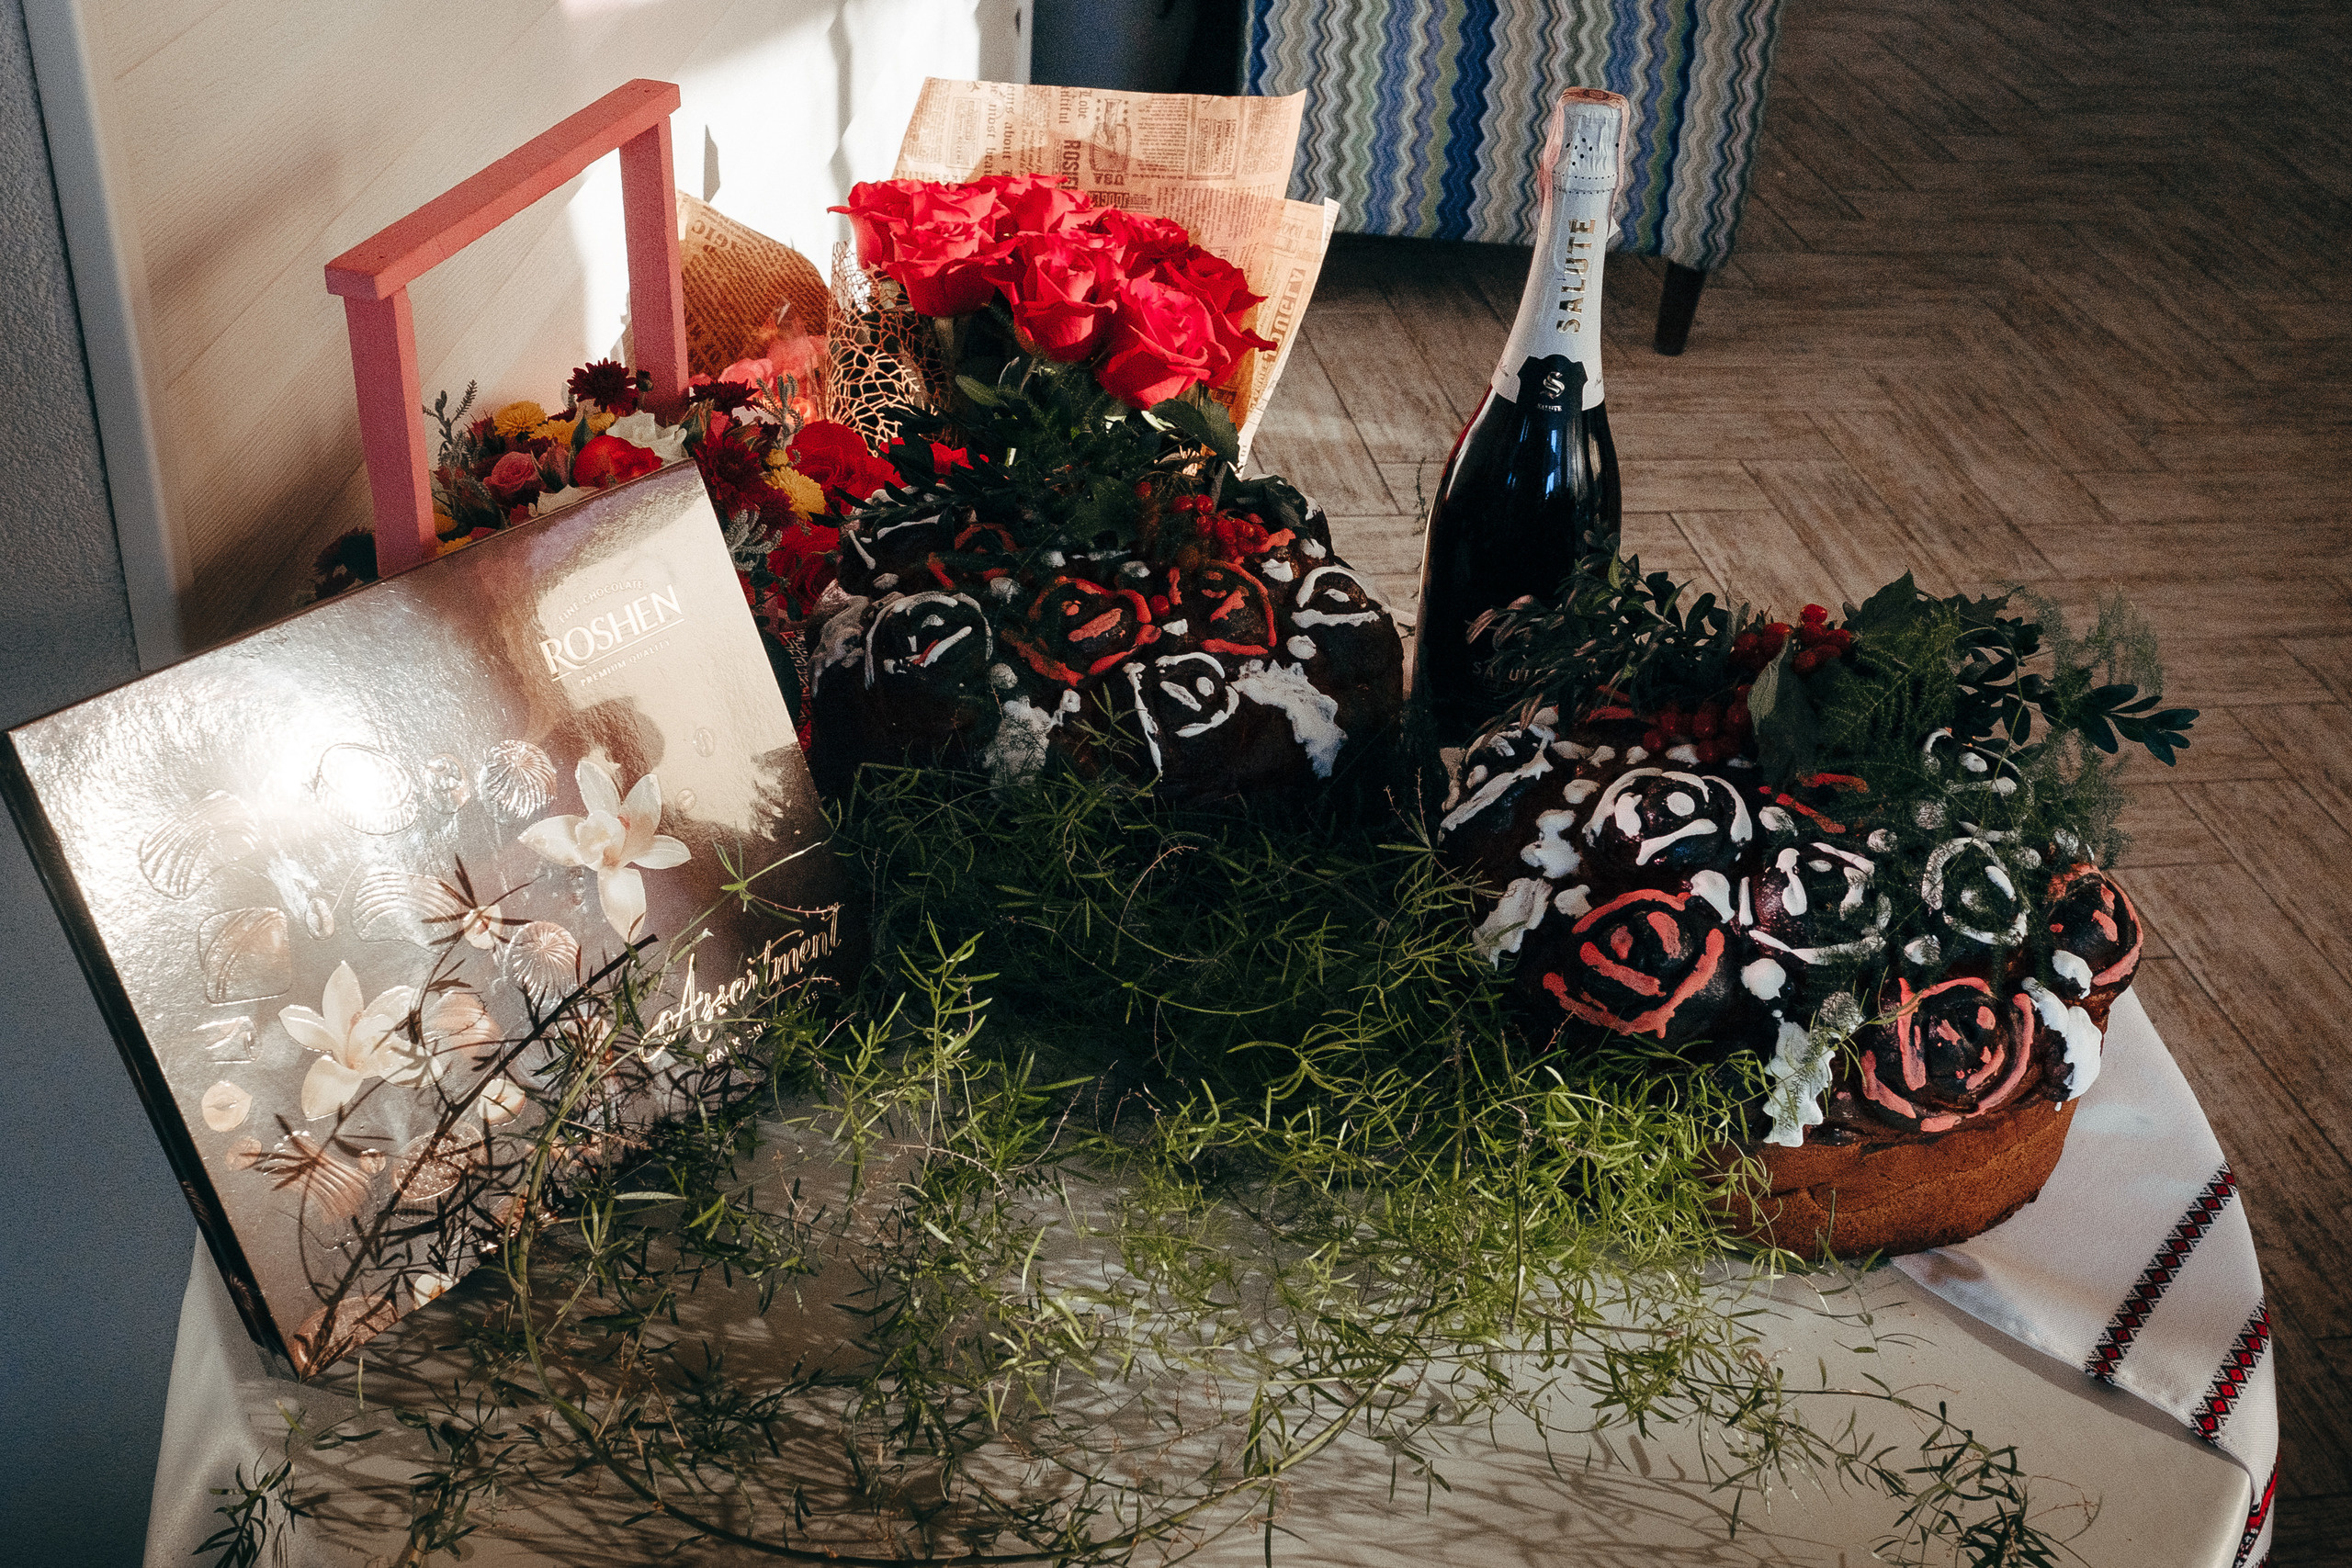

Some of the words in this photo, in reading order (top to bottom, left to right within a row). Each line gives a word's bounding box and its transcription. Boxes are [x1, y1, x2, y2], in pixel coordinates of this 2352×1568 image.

[982, 147, 997, 176] beau
[1001, 121, 1015, 161] about
[1060, 140, 1082, 191] ROSIE
[1093, 173, 1124, 186] USA
[1555, 218, 1596, 334] SALUTE
[558, 601, 581, 624] FINE
[582, 579, 644, 605] CHOCOLATE
[538, 583, 683, 675] ROSHEN
[580, 660, 628, 687] PREMIUM
[629, 639, 671, 665] QUALITY
[638, 903, 844, 1064] Assortment
